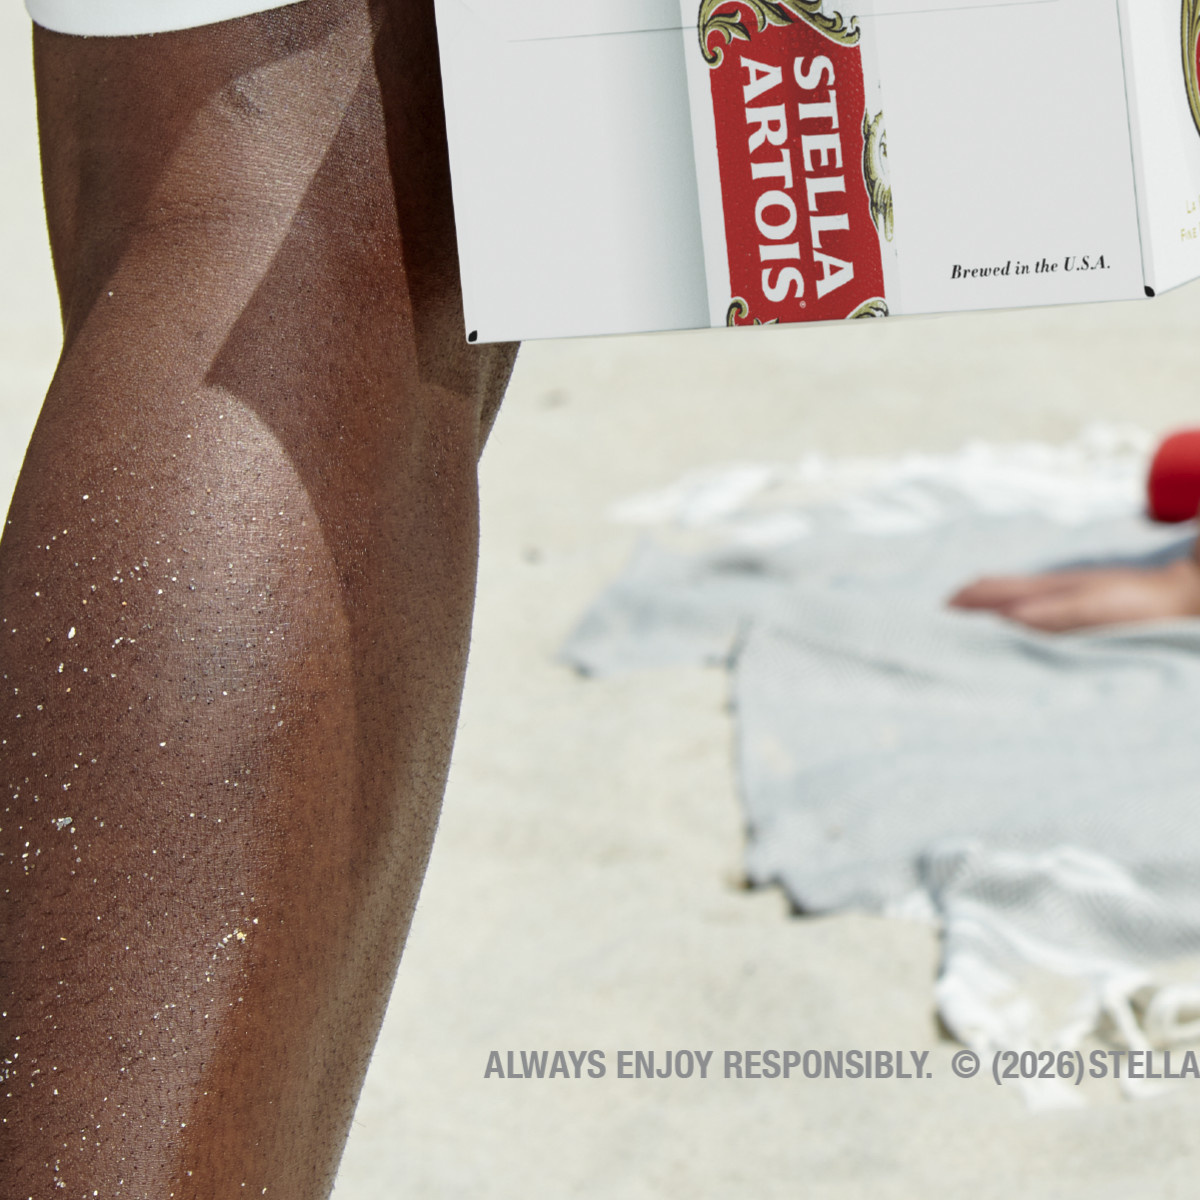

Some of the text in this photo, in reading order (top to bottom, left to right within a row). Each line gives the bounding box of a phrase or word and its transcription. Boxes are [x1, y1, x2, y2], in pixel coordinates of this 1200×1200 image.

[793, 54, 855, 300] STELLA
[950, 254, 1111, 279] Brewed in the U.S.A.
